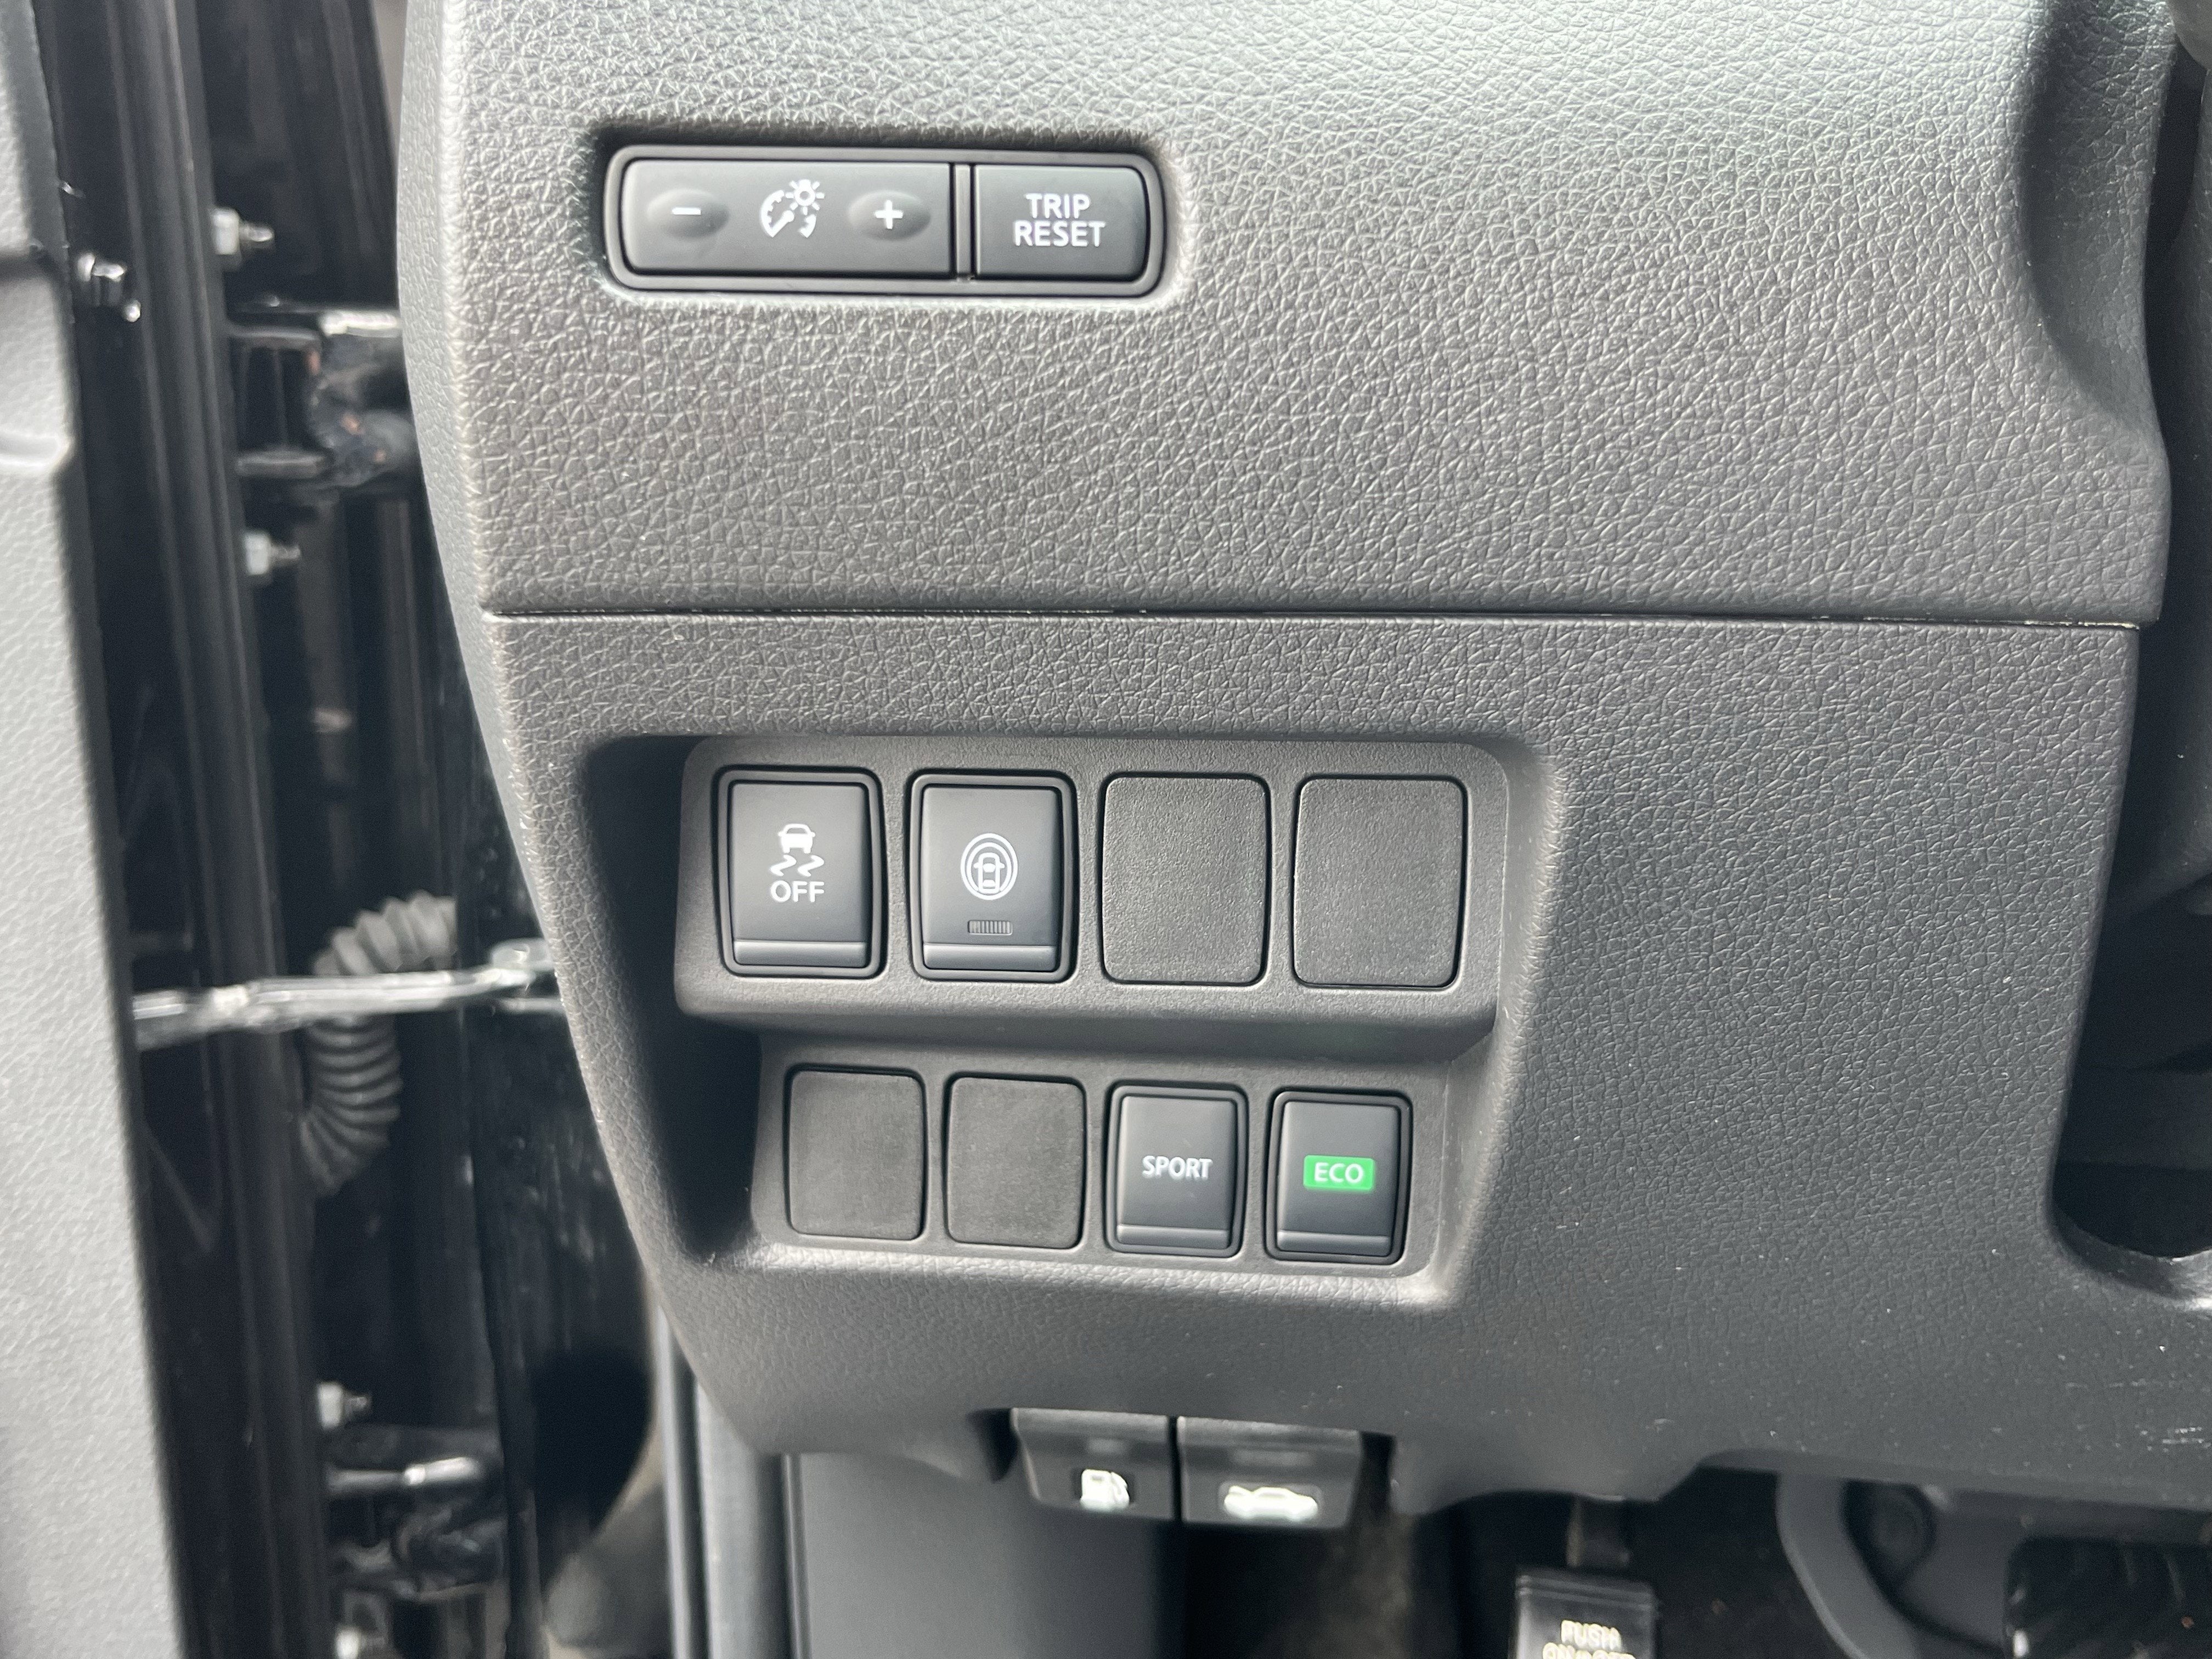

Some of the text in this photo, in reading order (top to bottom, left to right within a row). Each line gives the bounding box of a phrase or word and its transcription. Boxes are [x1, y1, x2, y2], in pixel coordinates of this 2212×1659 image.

[1025, 193, 1091, 218] TRIP
[1014, 221, 1106, 247] RESET
[770, 880, 825, 903] OFF
[1142, 1155, 1213, 1180] SPORT
[1314, 1162, 1364, 1183] ECO
